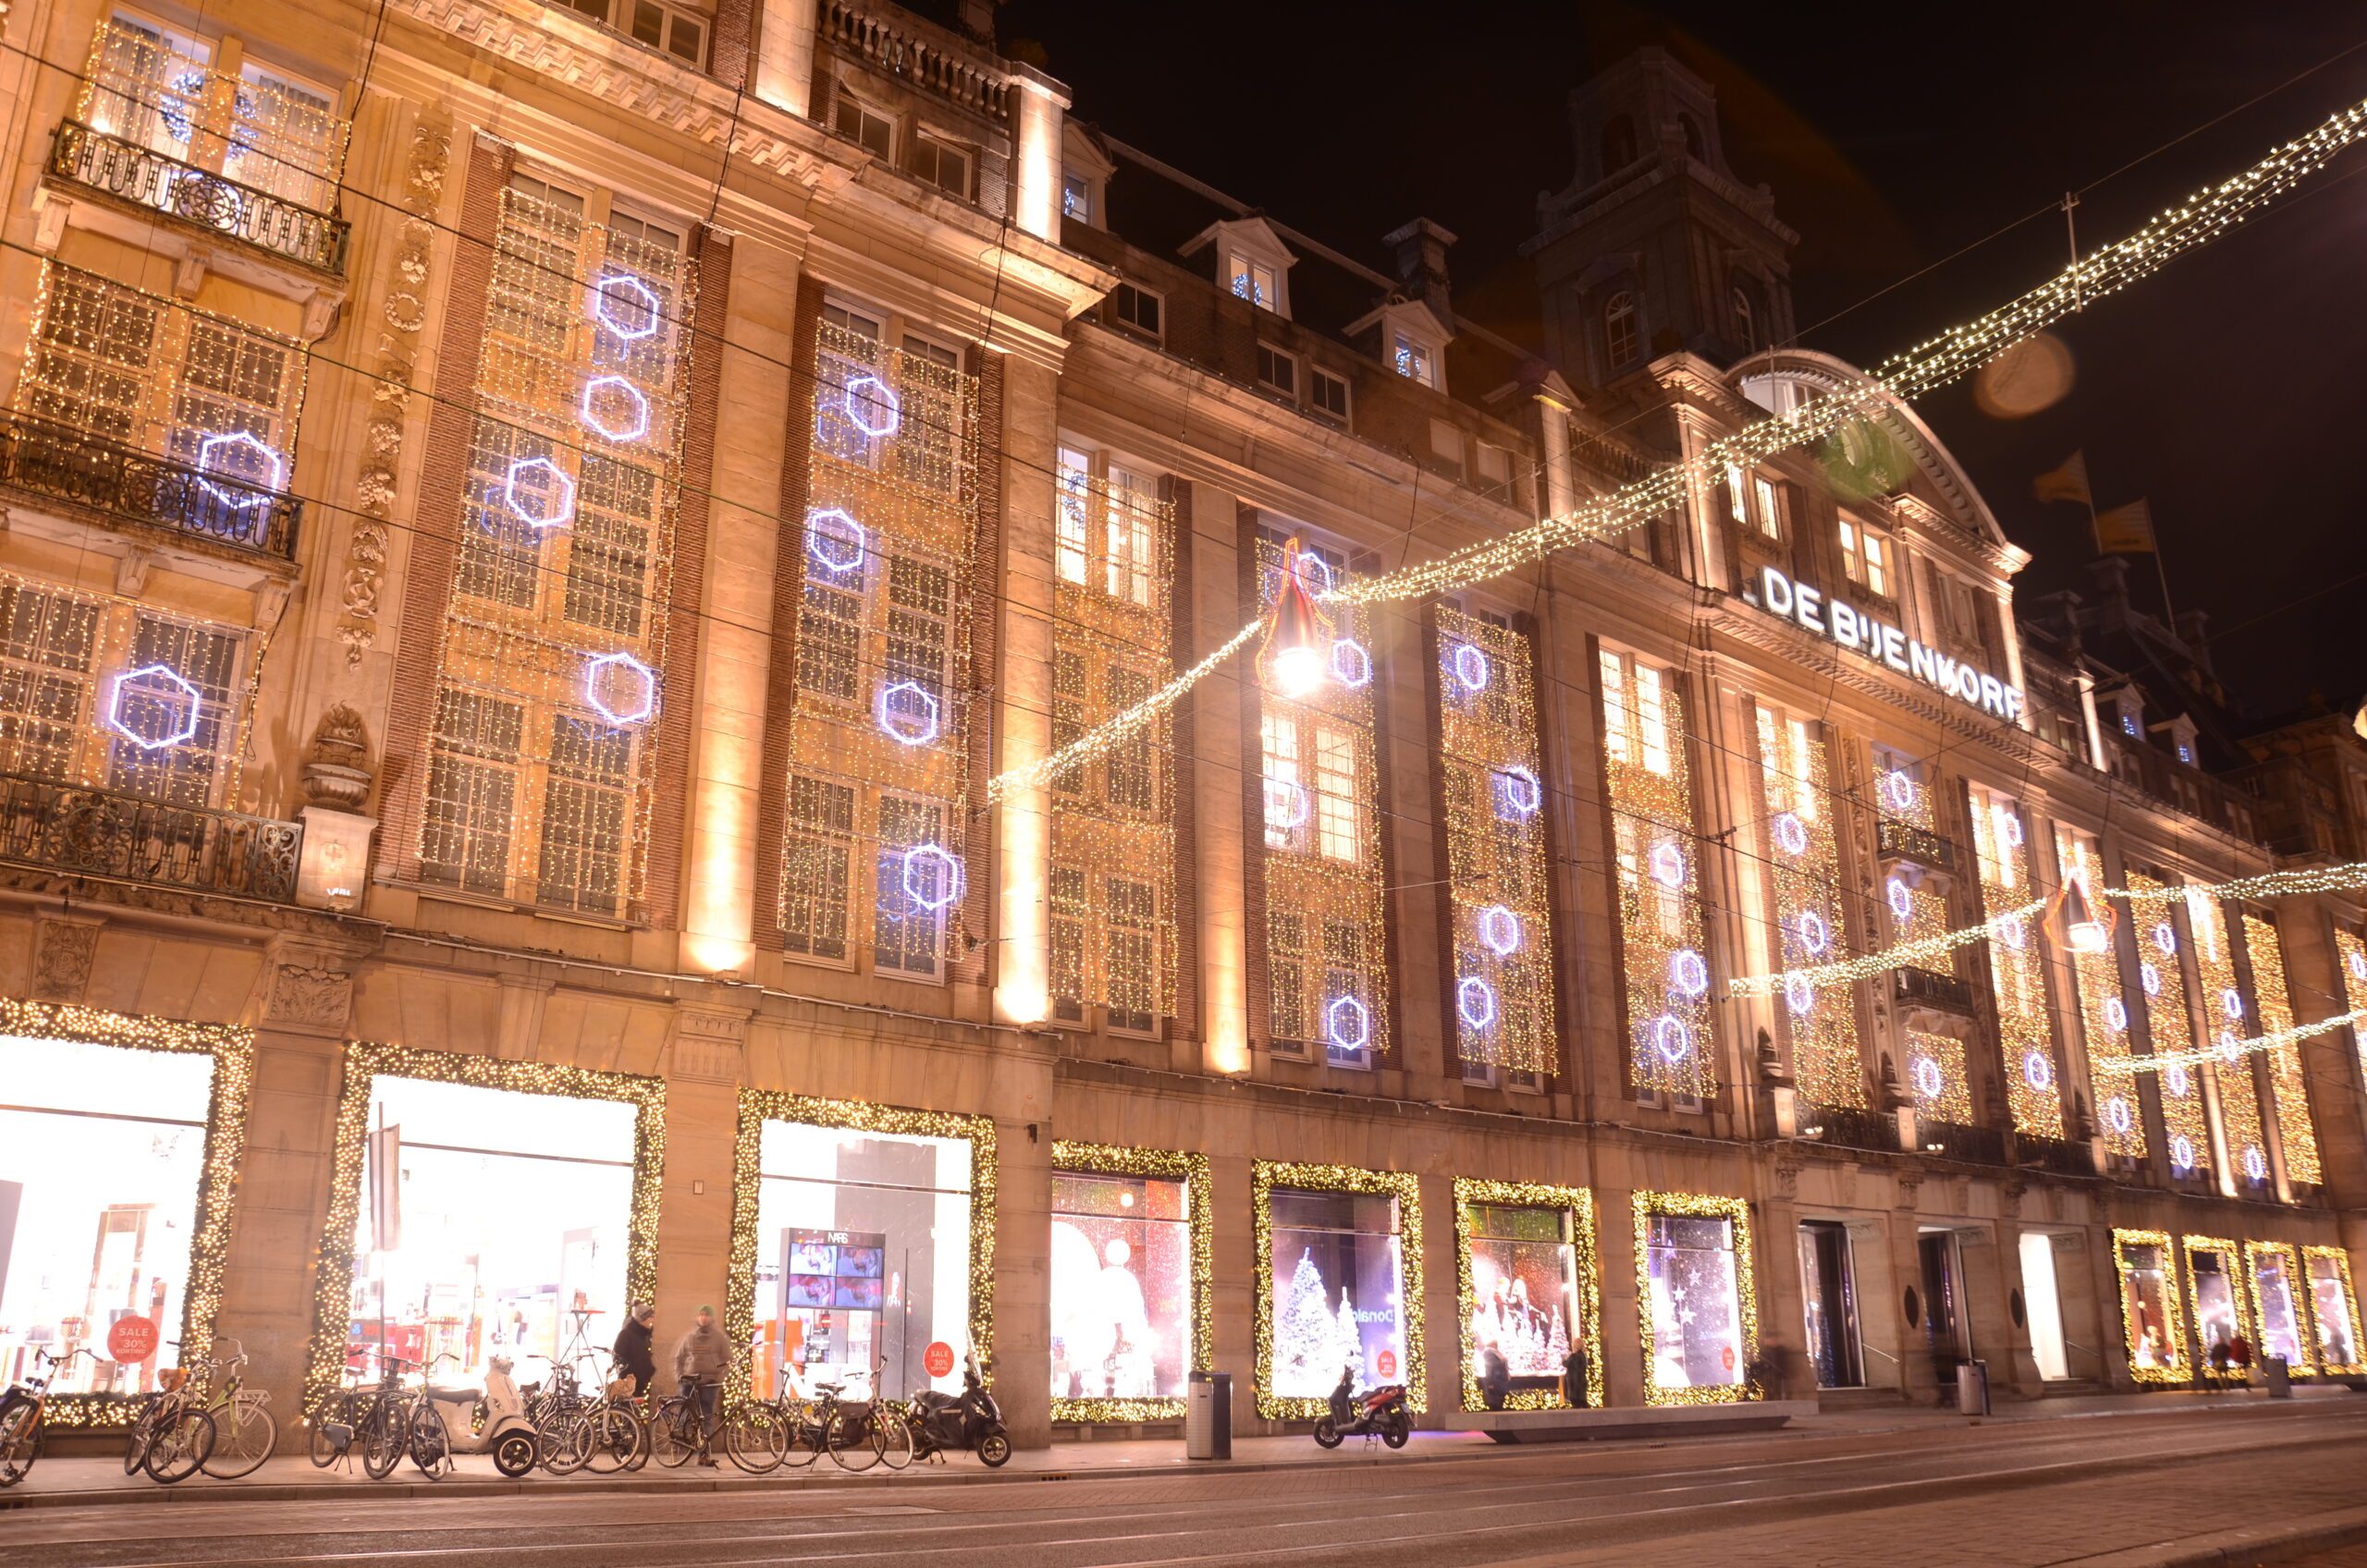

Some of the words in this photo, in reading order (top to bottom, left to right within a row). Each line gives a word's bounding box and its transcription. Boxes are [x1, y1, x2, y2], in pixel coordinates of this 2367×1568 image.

[1762, 566, 1824, 632] DE
[828, 1231, 848, 1243] NARS
[118, 1328, 148, 1337] SALE
[123, 1339, 147, 1349] 30%
[930, 1350, 949, 1358] SALE
